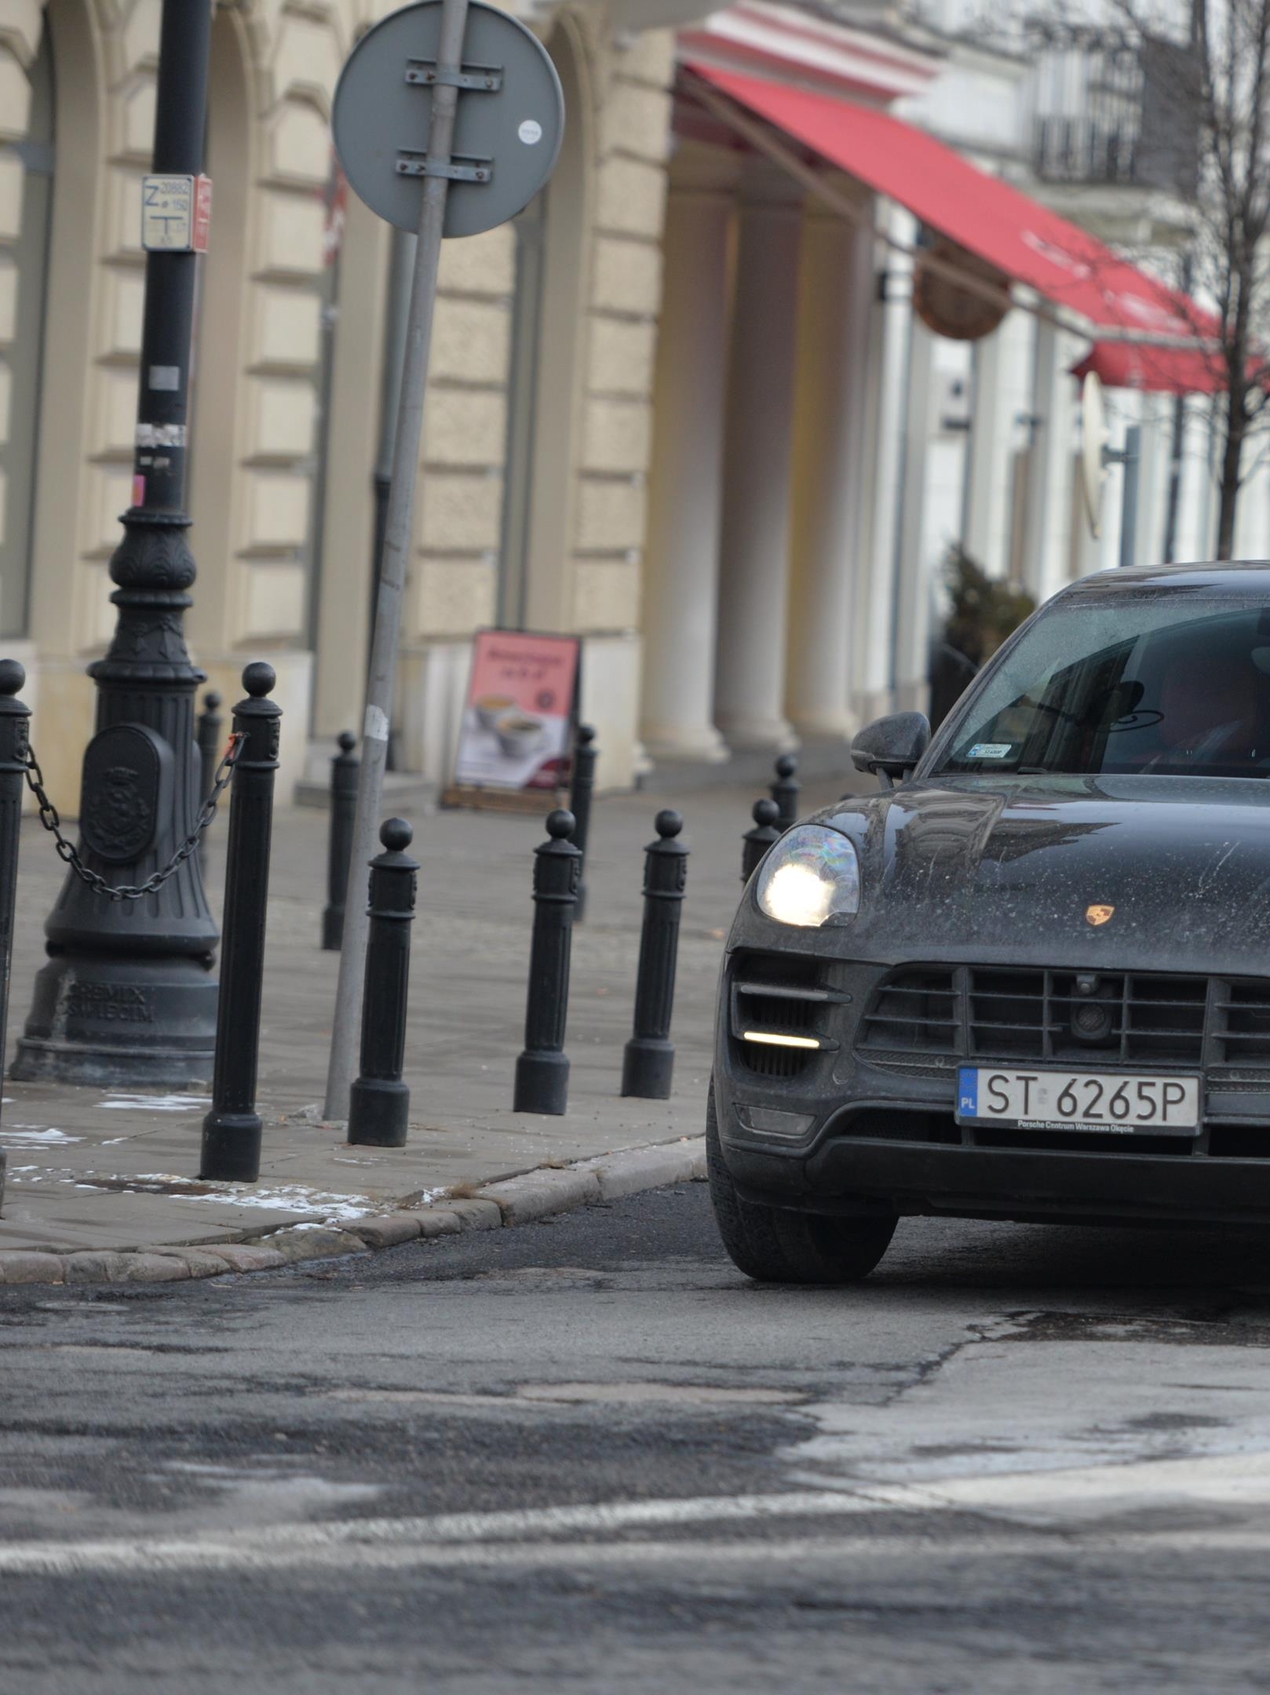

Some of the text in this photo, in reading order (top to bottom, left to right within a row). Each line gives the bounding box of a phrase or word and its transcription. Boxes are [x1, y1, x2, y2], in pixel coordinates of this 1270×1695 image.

[145, 186, 159, 206] Z
[961, 1097, 975, 1109] PL
[987, 1074, 1186, 1121] ST 6265P
[1018, 1119, 1134, 1134] Porsche Centrum Warszawa Okęcie
